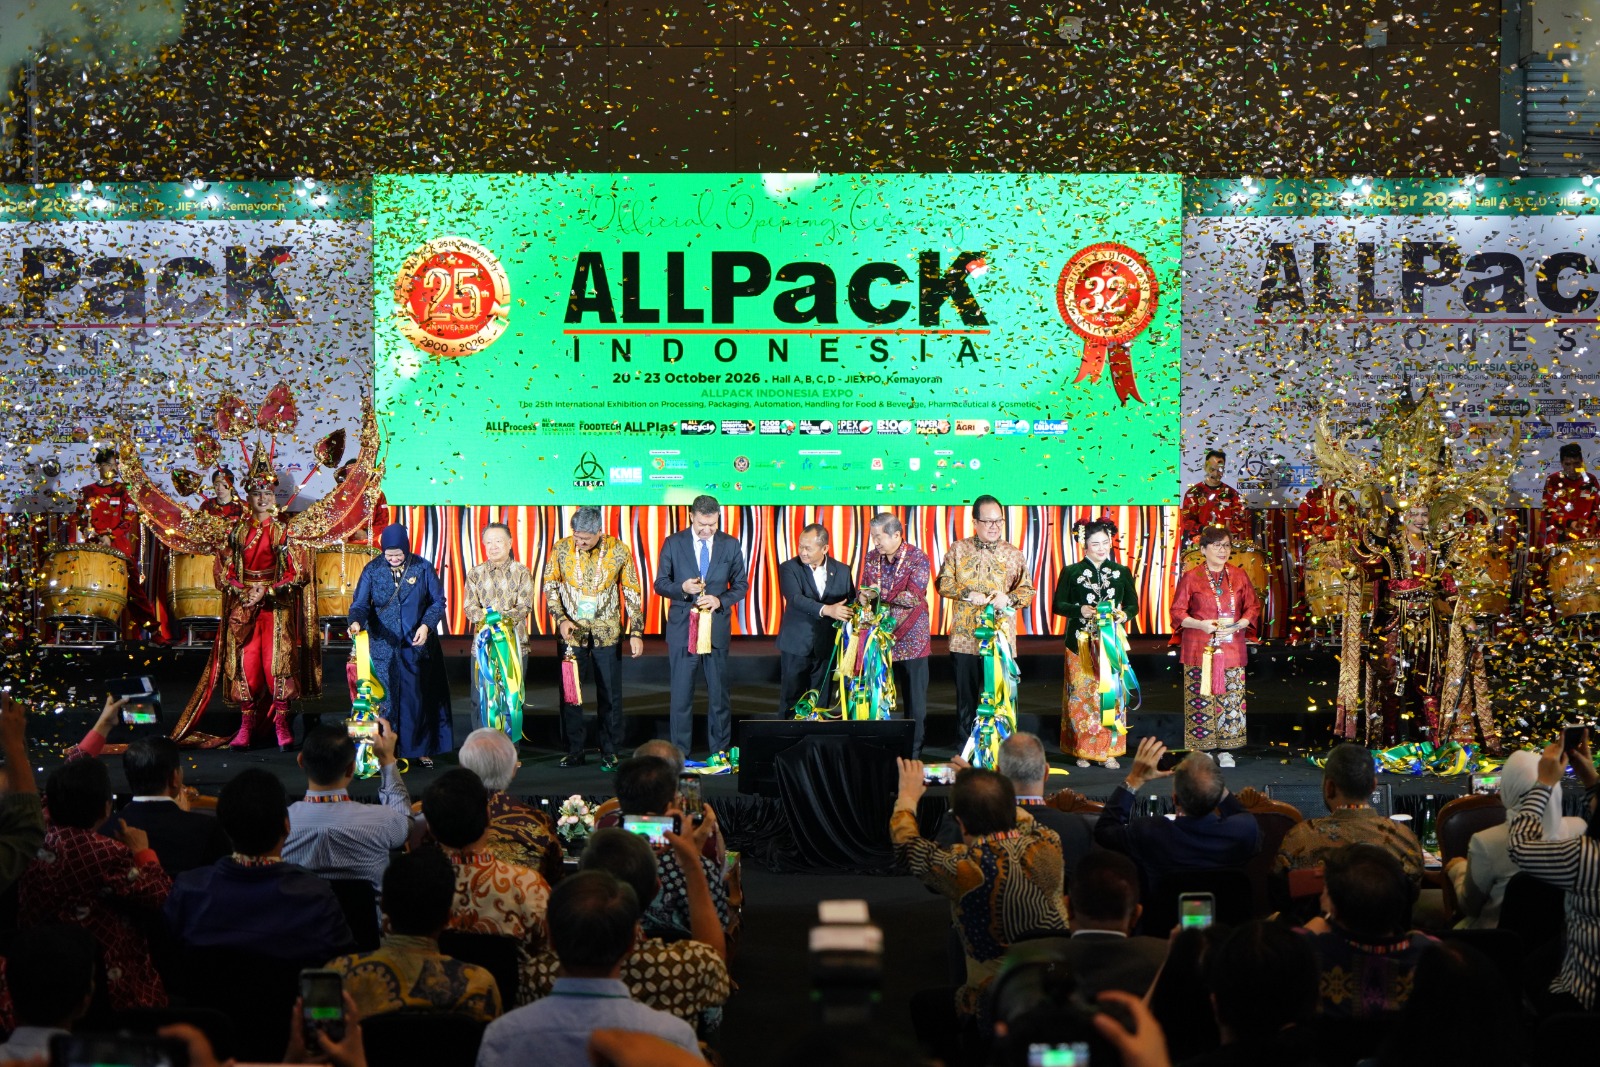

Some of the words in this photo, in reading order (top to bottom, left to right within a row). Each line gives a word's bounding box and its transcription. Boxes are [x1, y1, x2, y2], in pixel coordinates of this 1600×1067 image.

[1340, 188, 1417, 207] ctober
[573, 338, 979, 363] INDONESIA
[1509, 363, 1539, 371] EXPO
[613, 373, 631, 384] 20
[644, 373, 661, 384] 23
[665, 372, 721, 384] October
[725, 373, 761, 384] 2026
[772, 375, 791, 384] Hall
[827, 375, 836, 384] D
[886, 375, 943, 385] Kemayoran
[701, 389, 754, 398] ALLPACK
[756, 389, 819, 398] INDONESIA
[822, 389, 854, 398] EXPO
[804, 401, 840, 409] Handling
[579, 423, 622, 431] FOODTECH
[624, 421, 676, 432] ALLPlas
